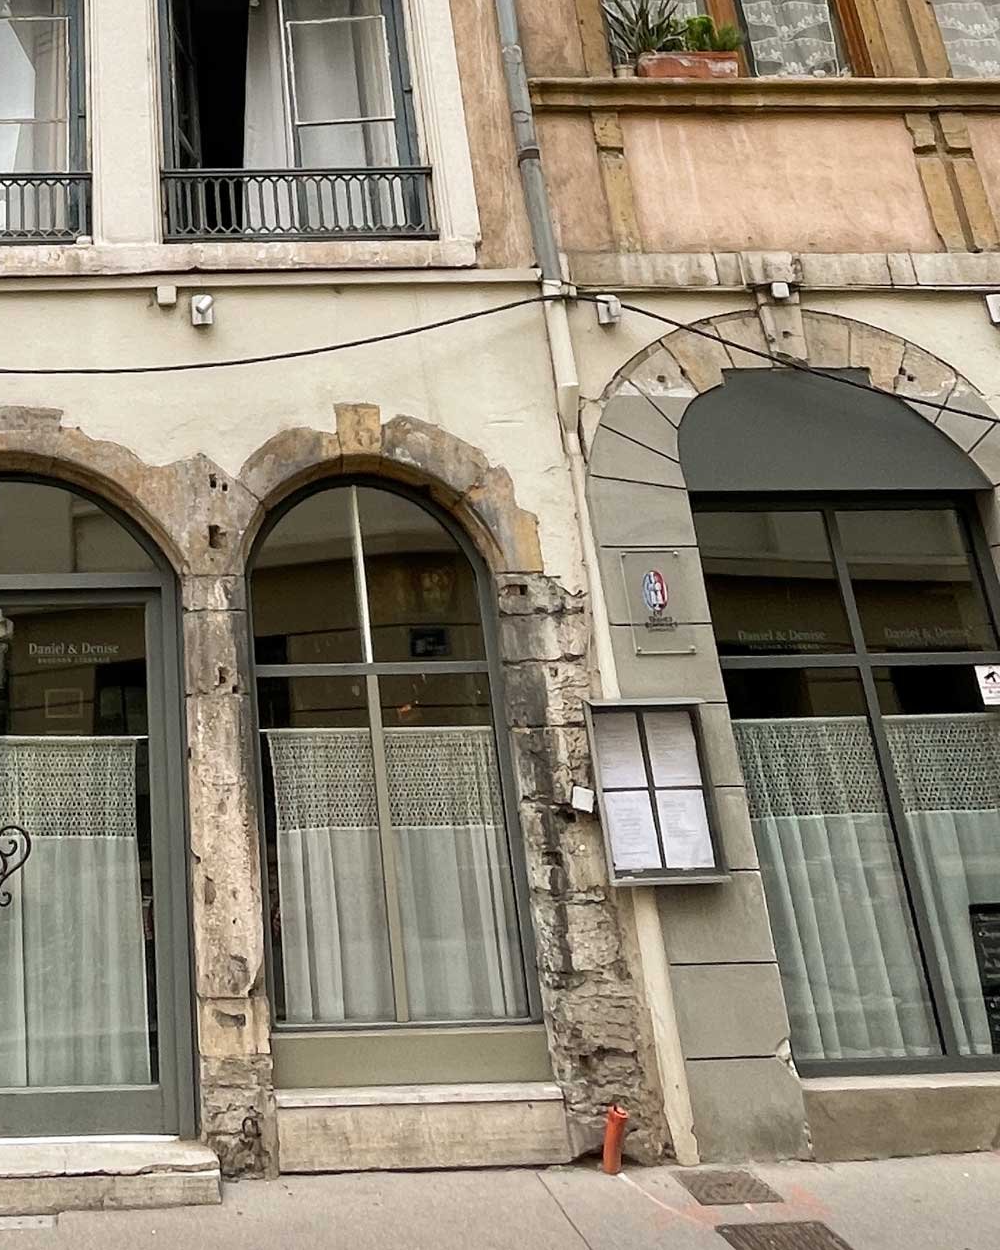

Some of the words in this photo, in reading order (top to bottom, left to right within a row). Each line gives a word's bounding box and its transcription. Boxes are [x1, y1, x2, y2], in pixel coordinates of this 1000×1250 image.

[28, 642, 64, 655] Daniel
[67, 644, 78, 654] &
[81, 642, 119, 654] Denise
